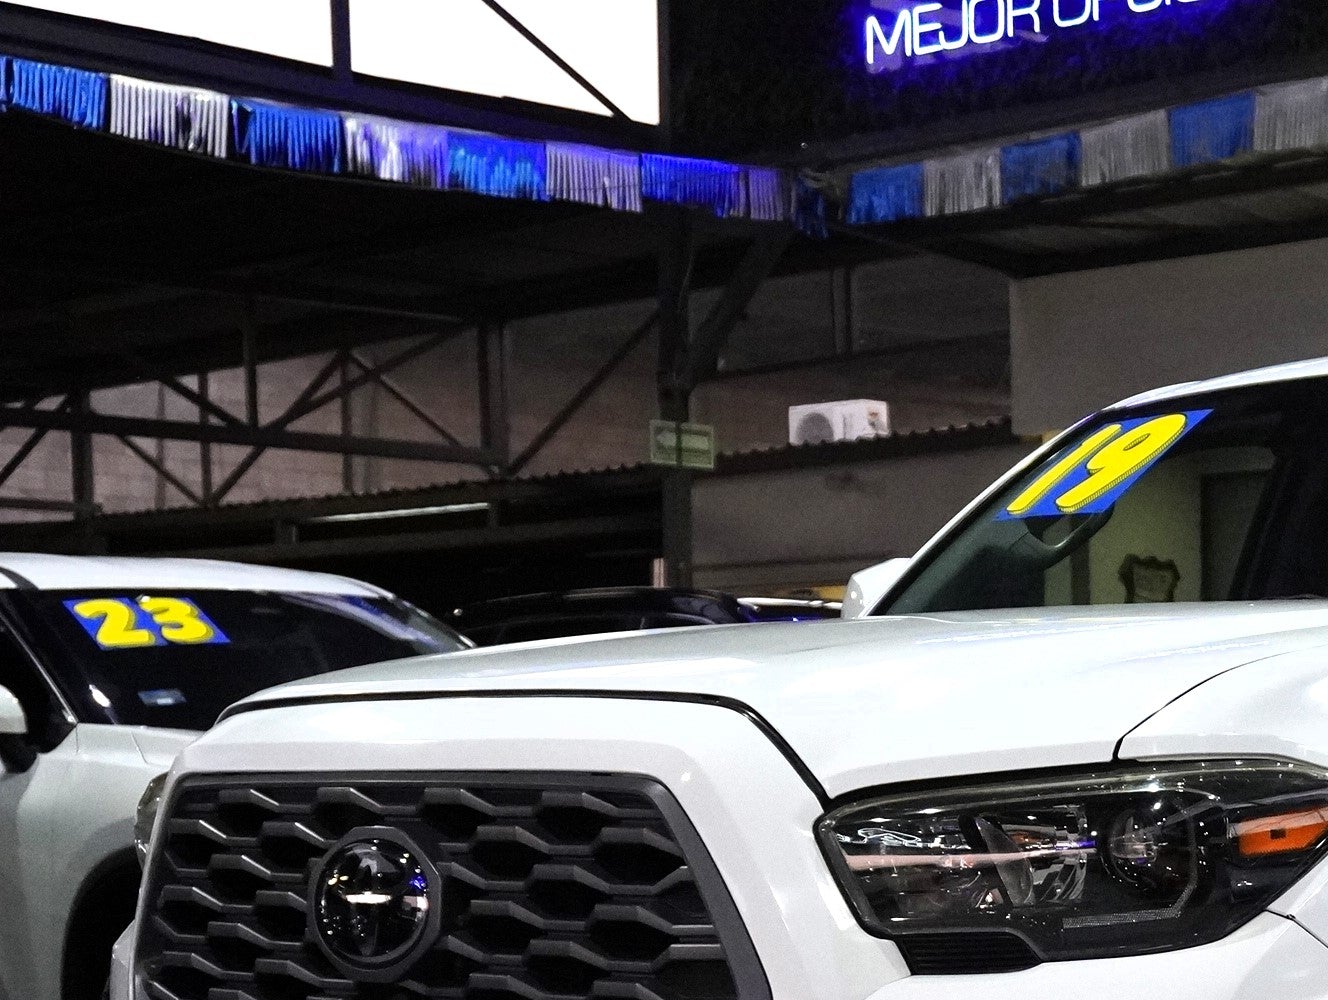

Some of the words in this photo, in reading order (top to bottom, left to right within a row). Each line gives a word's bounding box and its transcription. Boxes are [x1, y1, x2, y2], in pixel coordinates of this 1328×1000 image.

[865, 0, 1041, 65] MEJOR
[1006, 413, 1187, 514] 19
[74, 597, 214, 648] 23
